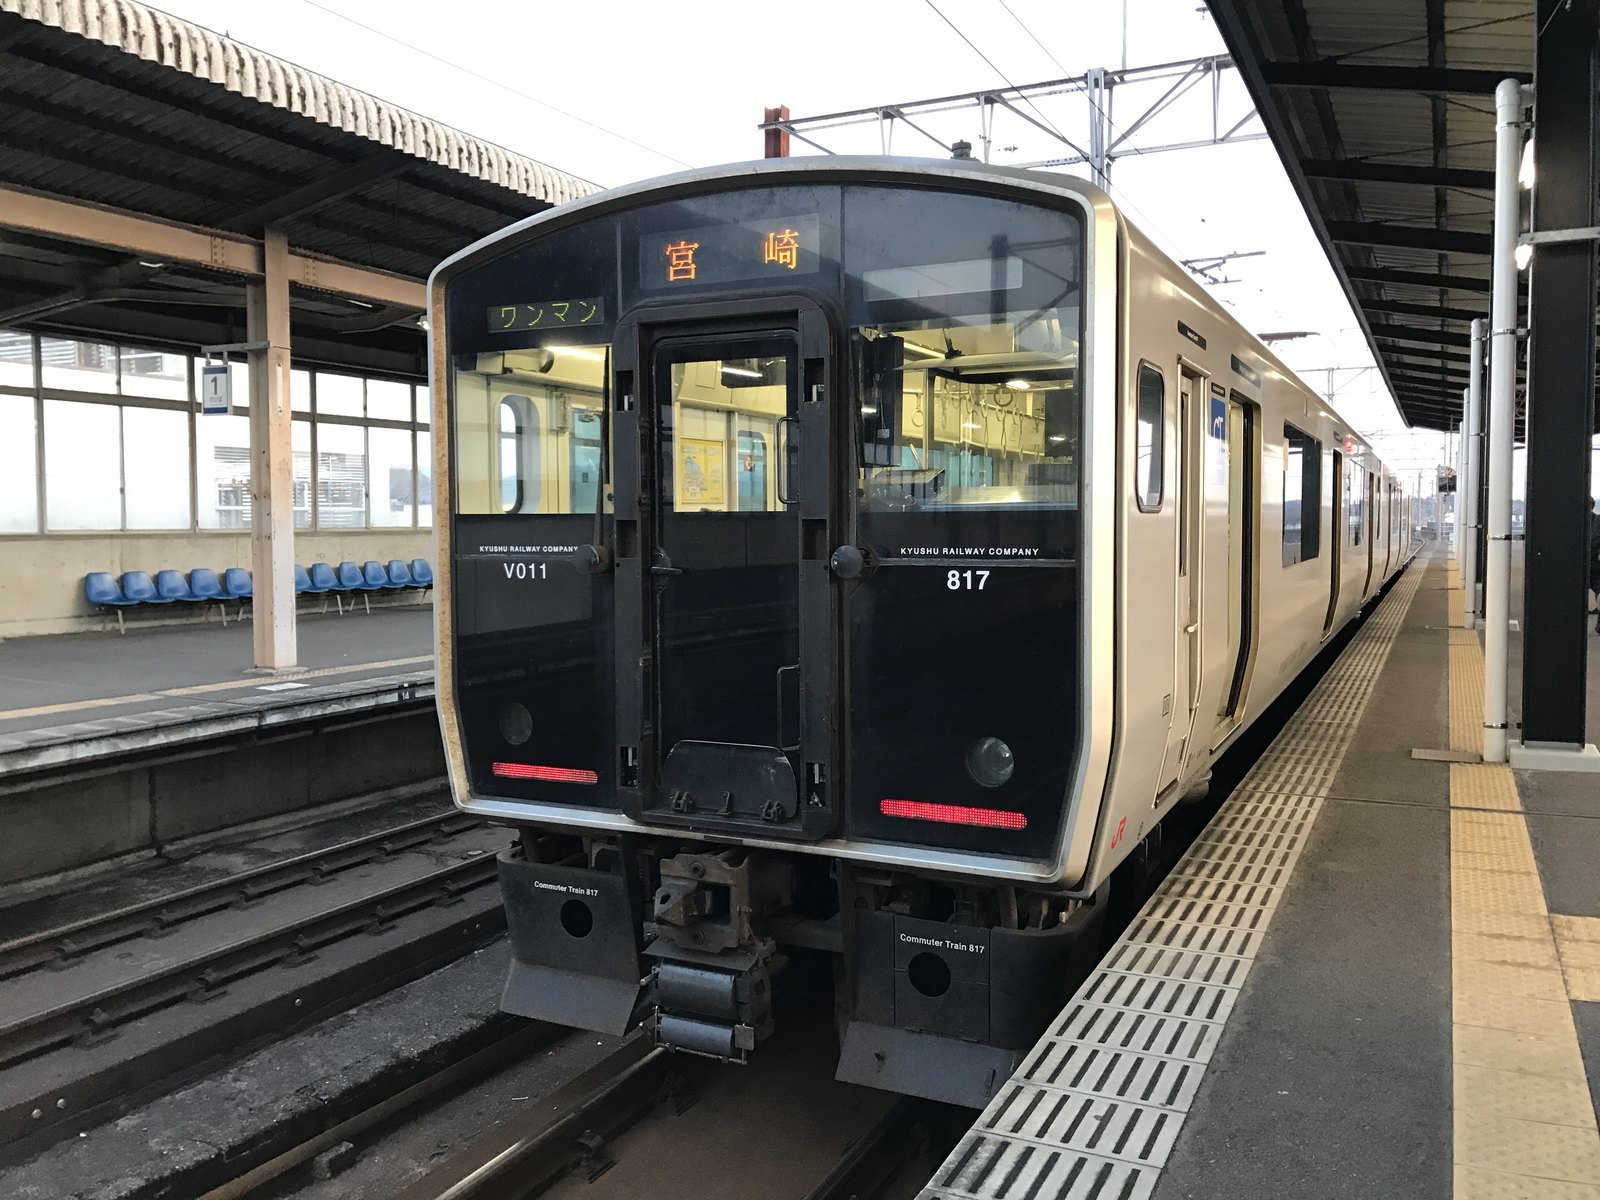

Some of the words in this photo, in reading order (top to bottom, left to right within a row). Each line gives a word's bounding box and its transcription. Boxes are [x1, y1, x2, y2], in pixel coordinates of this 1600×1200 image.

[665, 228, 800, 281] 宮崎
[501, 301, 596, 328] ワンマン
[211, 376, 217, 395] 1
[900, 547, 939, 555] KYUSHU
[942, 547, 985, 556] RAILWAY
[988, 547, 1039, 556] COMPANY
[503, 562, 547, 579] V011
[946, 569, 990, 590] 817
[1110, 815, 1127, 850] JR
[534, 881, 567, 891] Commuter
[568, 885, 585, 895] Train
[586, 888, 598, 896] 817
[900, 934, 943, 947] Commuter
[945, 940, 967, 951] Train
[969, 944, 984, 953] 817
